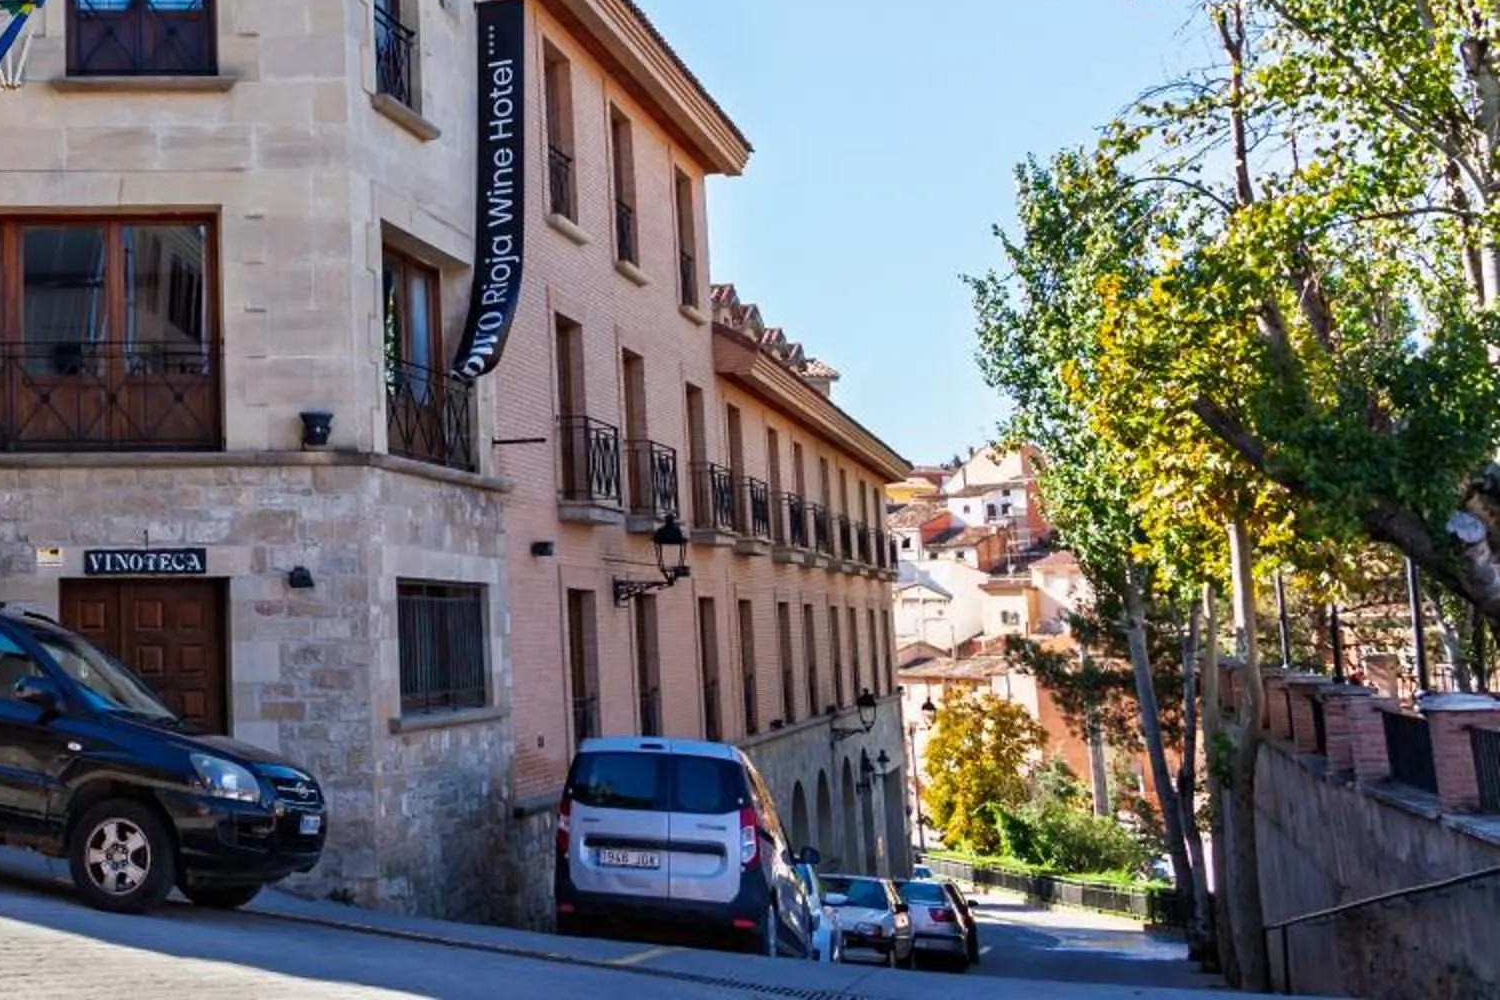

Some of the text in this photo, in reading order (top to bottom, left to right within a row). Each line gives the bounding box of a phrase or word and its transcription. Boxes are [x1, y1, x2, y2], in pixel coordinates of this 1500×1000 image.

[487, 58, 514, 141] Hotel
[486, 147, 514, 228] Wine
[482, 234, 520, 305] Rioja
[88, 552, 203, 572] VINOTECA
